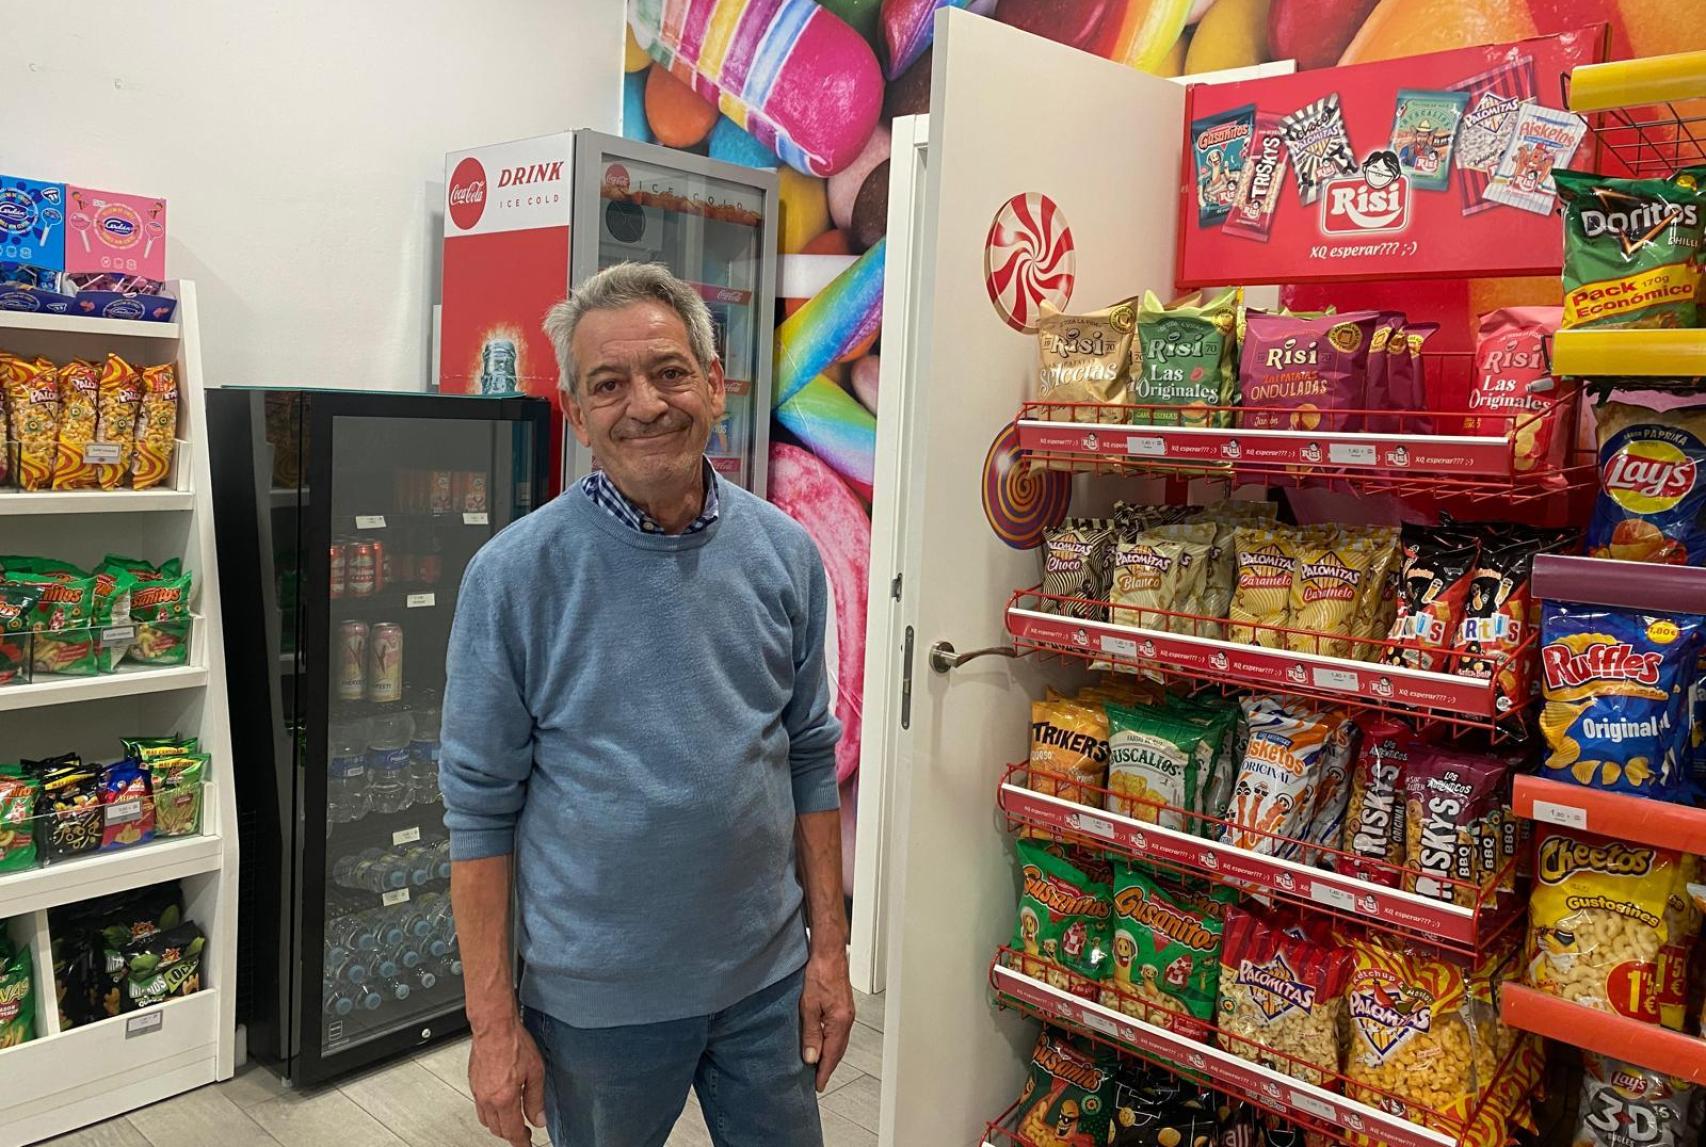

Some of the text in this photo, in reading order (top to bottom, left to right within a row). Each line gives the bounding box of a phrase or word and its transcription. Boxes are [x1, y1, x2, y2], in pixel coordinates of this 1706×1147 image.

[498, 161, 564, 188] DRINK
[1251, 136, 1281, 198] TRISKYS
[500, 194, 560, 209] ICE COLD
[1331, 181, 1402, 227] Risi
[1581, 202, 1698, 237] Doritos
[1310, 245, 1327, 259] XQ
[1330, 242, 1400, 260] esperar???
[1572, 281, 1637, 306] Pack
[1576, 283, 1694, 320] Económico
[1050, 328, 1104, 358] Risi
[1147, 331, 1205, 363] Risi
[1266, 338, 1319, 370] Risi
[1483, 339, 1542, 374] Risi
[1151, 364, 1184, 381] Las
[1483, 375, 1516, 391] Las
[1136, 377, 1219, 404] Originales
[1251, 379, 1328, 401] ONDULADAS
[1469, 388, 1553, 418] Originales
[1643, 428, 1689, 446] PAPRIKA
[1046, 553, 1081, 572] Choco
[1115, 551, 1173, 573] PALOMITAS
[1300, 563, 1361, 586] PALOMITAS
[1120, 575, 1161, 590] Blanco
[1240, 573, 1292, 587] Caramelo
[1304, 587, 1353, 602] Caramelo
[1542, 643, 1664, 689] Ruffles
[1032, 721, 1112, 762] TRIKERS
[1583, 717, 1659, 743] Original
[1483, 837, 1495, 870] BBQ
[1504, 823, 1515, 855] BBQ
[1459, 846, 1471, 877] BBQ
[1541, 837, 1653, 884] Cheetos
[1115, 886, 1222, 950] Gusanitos
[1239, 960, 1315, 1012] PALOMITAS
